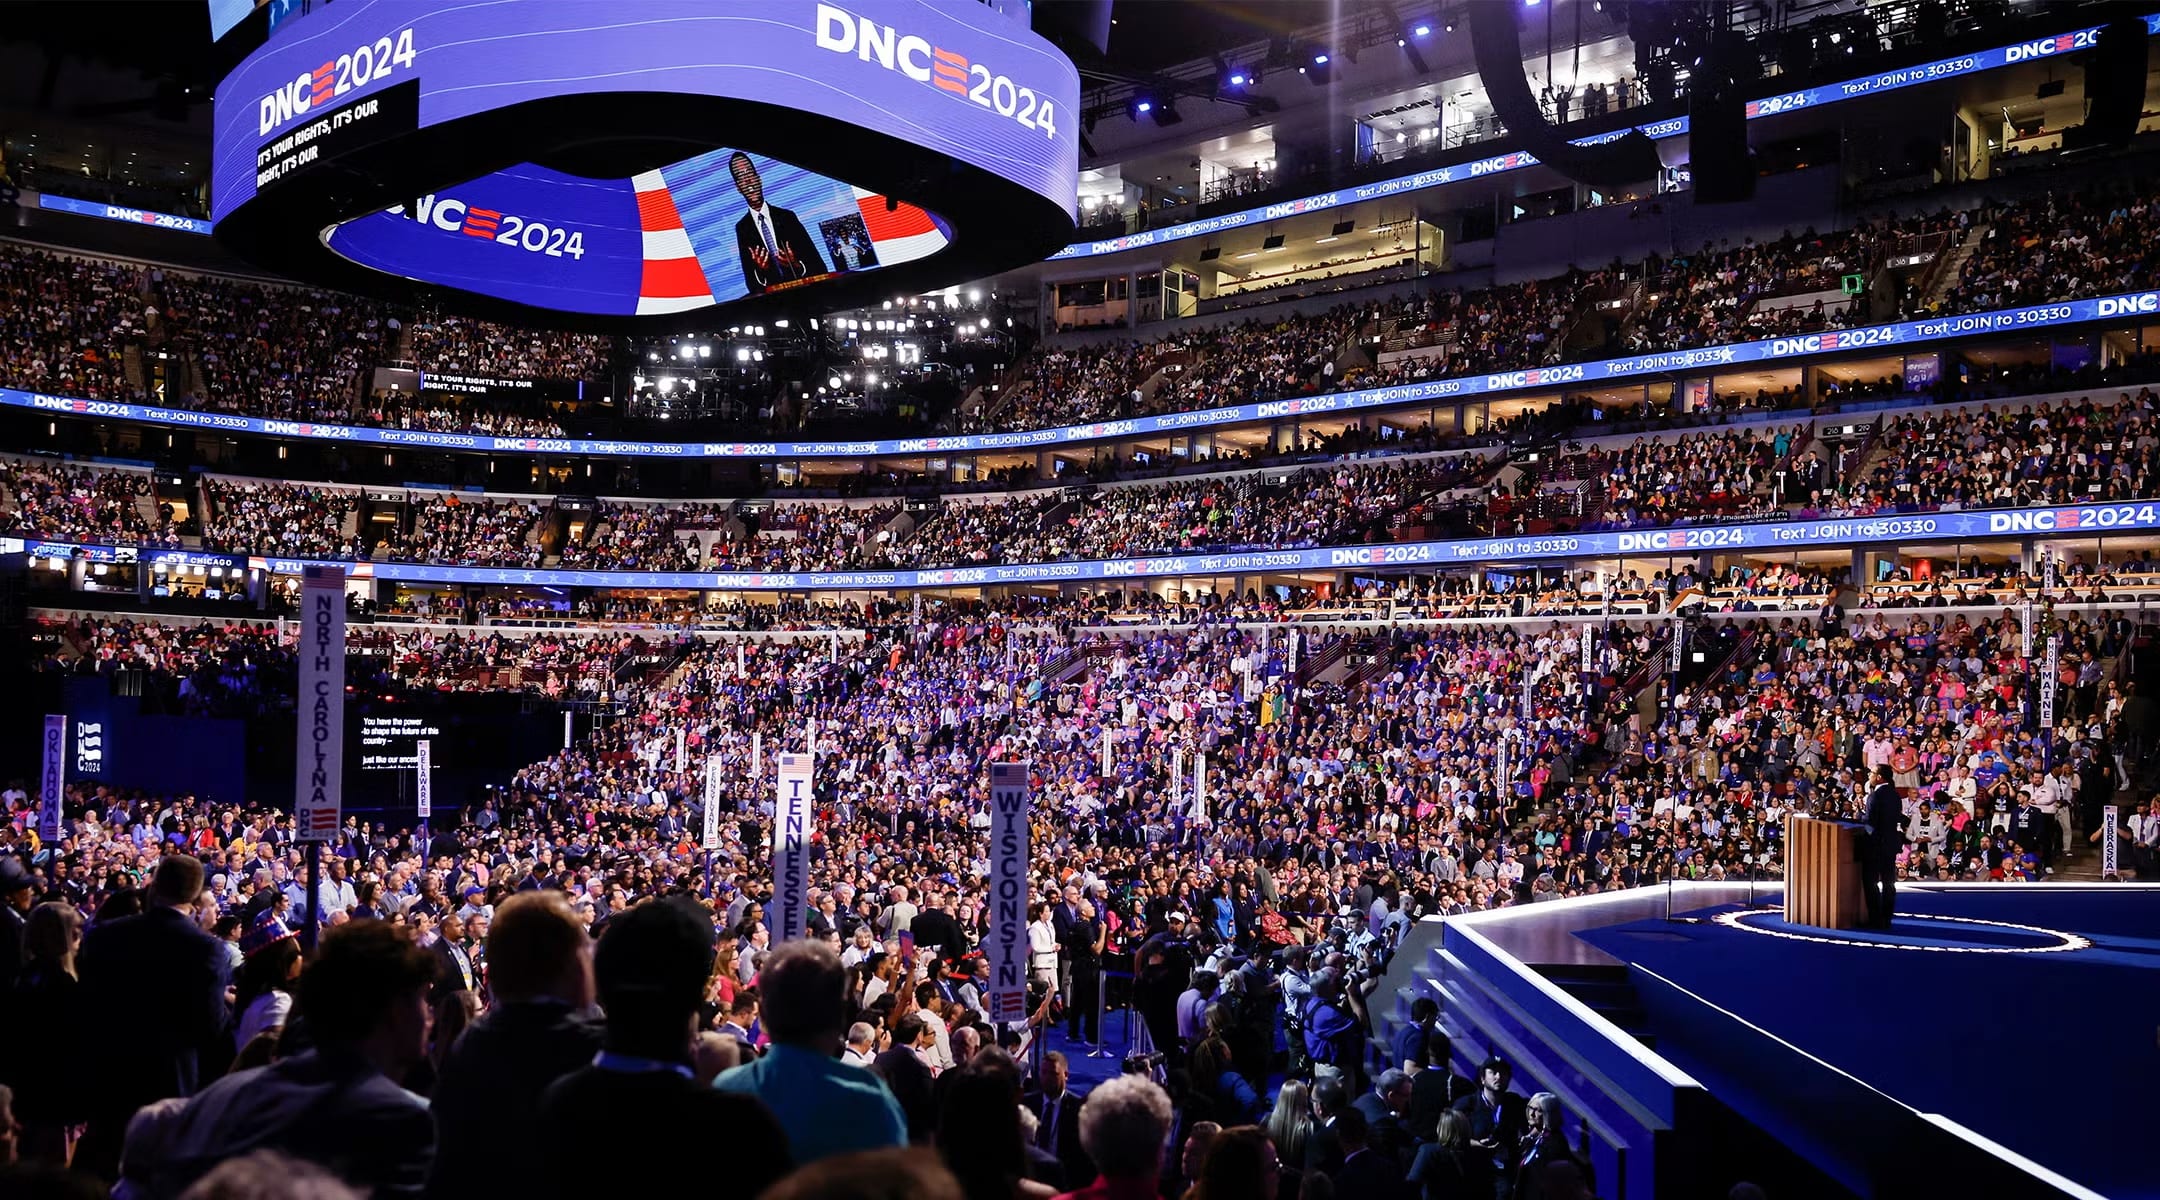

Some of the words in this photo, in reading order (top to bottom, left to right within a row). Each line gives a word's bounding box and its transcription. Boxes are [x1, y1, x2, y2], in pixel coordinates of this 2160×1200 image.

[2074, 29, 2097, 47] 20
[334, 28, 416, 96] 2024
[1841, 82, 1869, 96] Text
[1873, 73, 1906, 89] JOIN
[1910, 70, 1924, 81] to
[1927, 59, 1973, 77] 30330
[969, 64, 1056, 140] 2024
[1759, 94, 1805, 114] 2024
[1644, 121, 1682, 136] 30330
[1517, 153, 1540, 166] 20
[1355, 187, 1375, 198] Text
[1376, 181, 1401, 195] JOIN
[1402, 178, 1412, 189] to
[1304, 194, 1336, 210] 2024
[155, 215, 193, 229] 2024
[496, 216, 584, 260] 2024
[1126, 232, 1154, 248] 2024
[1915, 323, 1947, 337] Text
[1949, 316, 1991, 332] JOIN
[1997, 313, 2012, 327] to
[2017, 306, 2071, 323] 30330
[1838, 327, 1893, 348] 2024
[1607, 360, 1633, 373] Text
[1635, 356, 1667, 369] JOIN
[1671, 355, 1683, 366] to
[1539, 366, 1583, 383] 2024
[1381, 389, 1409, 400] JOIN
[1410, 387, 1422, 398] to
[1425, 382, 1460, 395] 30330
[86, 401, 129, 416] 2024
[1300, 396, 1335, 412] 2024
[144, 409, 167, 420] Text
[169, 411, 197, 422] JOIN
[200, 414, 211, 423] to
[213, 416, 248, 428] 30330
[1156, 419, 1173, 427] Text
[1174, 415, 1195, 426] JOIN
[1197, 414, 1207, 424] to
[1209, 410, 1239, 421] 30330
[311, 425, 349, 438] 2024
[1102, 422, 1132, 434] 2024
[379, 430, 400, 442] Text
[403, 433, 429, 444] JOIN
[430, 435, 440, 444] to
[441, 436, 474, 446] 30330
[537, 440, 571, 451] 2024
[936, 438, 968, 449] 2024
[979, 437, 998, 445] Text
[1000, 435, 1021, 444] JOIN
[1023, 434, 1031, 443] to
[1031, 431, 1056, 441] 30330
[744, 444, 776, 455] 2024
[2080, 505, 2156, 526] 2024
[1686, 527, 1743, 547] 2024
[1771, 526, 1806, 540] Text
[1810, 522, 1852, 540] JOIN
[1857, 520, 1873, 536] to
[1878, 518, 1936, 536] 30330
[1384, 546, 1429, 561] 2024
[1451, 544, 1479, 557] Text
[1480, 541, 1513, 556] JOIN
[1517, 540, 1530, 554] to
[1533, 538, 1578, 553] 30330
[190, 557, 232, 566] CHICAGO
[1145, 558, 1181, 574] 2024
[1200, 558, 1221, 569] Text
[1223, 556, 1249, 568] JOIN
[1251, 556, 1261, 567] to
[1265, 553, 1300, 566] 30330
[762, 574, 794, 585] 2024
[811, 575, 829, 585] Text
[831, 574, 855, 585] JOIN
[856, 574, 864, 584] to
[864, 573, 895, 584] 30330
[952, 571, 982, 582] 2024
[996, 568, 1014, 579] Text
[1016, 567, 1039, 578] JOIN
[1040, 567, 1049, 577] to
[1050, 565, 1079, 576] 30330
[315, 595, 331, 672] NORTH
[2042, 671, 2052, 719] MAINE
[363, 718, 375, 726] You
[77, 722, 85, 772] DNC
[84, 762, 101, 773] 2024
[311, 681, 329, 803] CAROLINA
[363, 738, 386, 746] country
[44, 729, 59, 823] OKLAHOMA
[420, 749, 428, 807] DELAWARE
[708, 766, 718, 837] PENNSYLVANIA
[300, 808, 310, 838] DNC
[2106, 814, 2115, 870] NEBRASKA
[783, 779, 804, 942] TENNESSEE
[996, 791, 1022, 987] WISCONSIN
